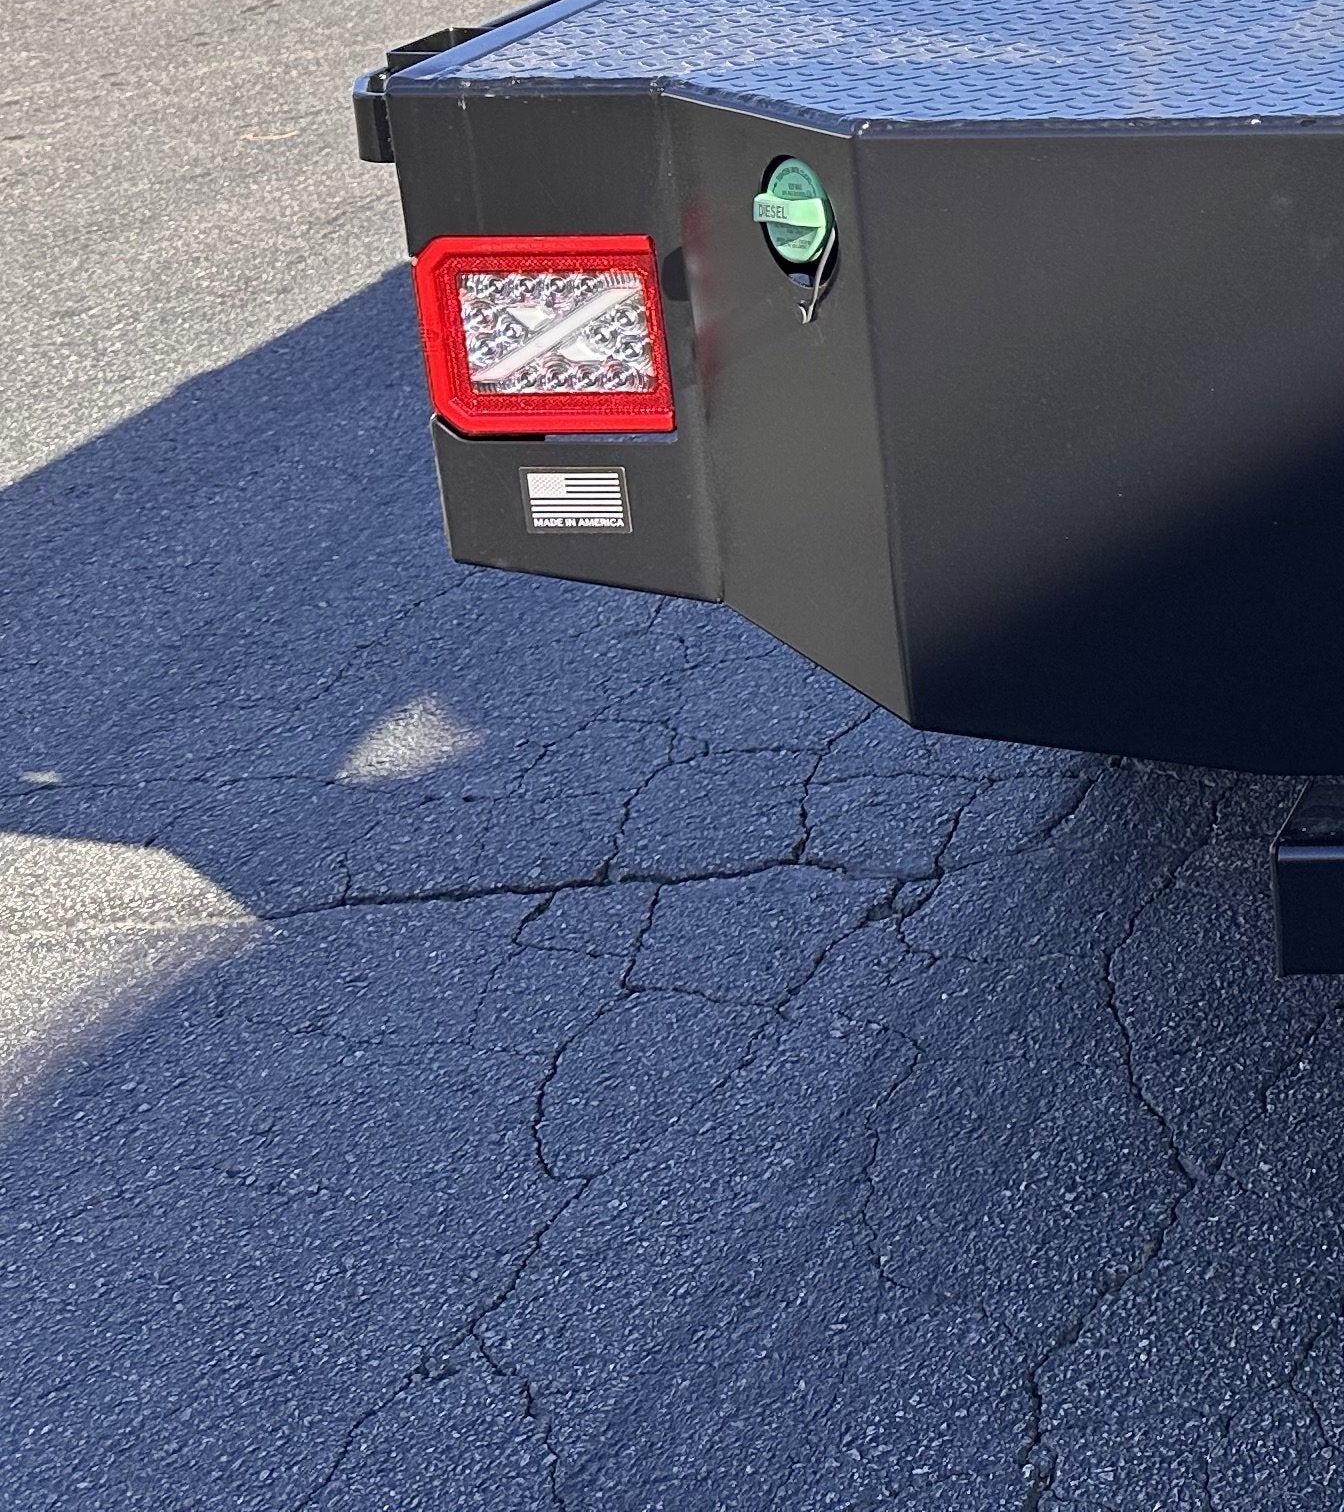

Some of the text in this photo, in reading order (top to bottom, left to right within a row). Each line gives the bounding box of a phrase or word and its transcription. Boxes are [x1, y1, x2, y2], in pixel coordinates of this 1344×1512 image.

[758, 203, 788, 219] DIESEL
[533, 518, 625, 527] MADE IN AMERICA
